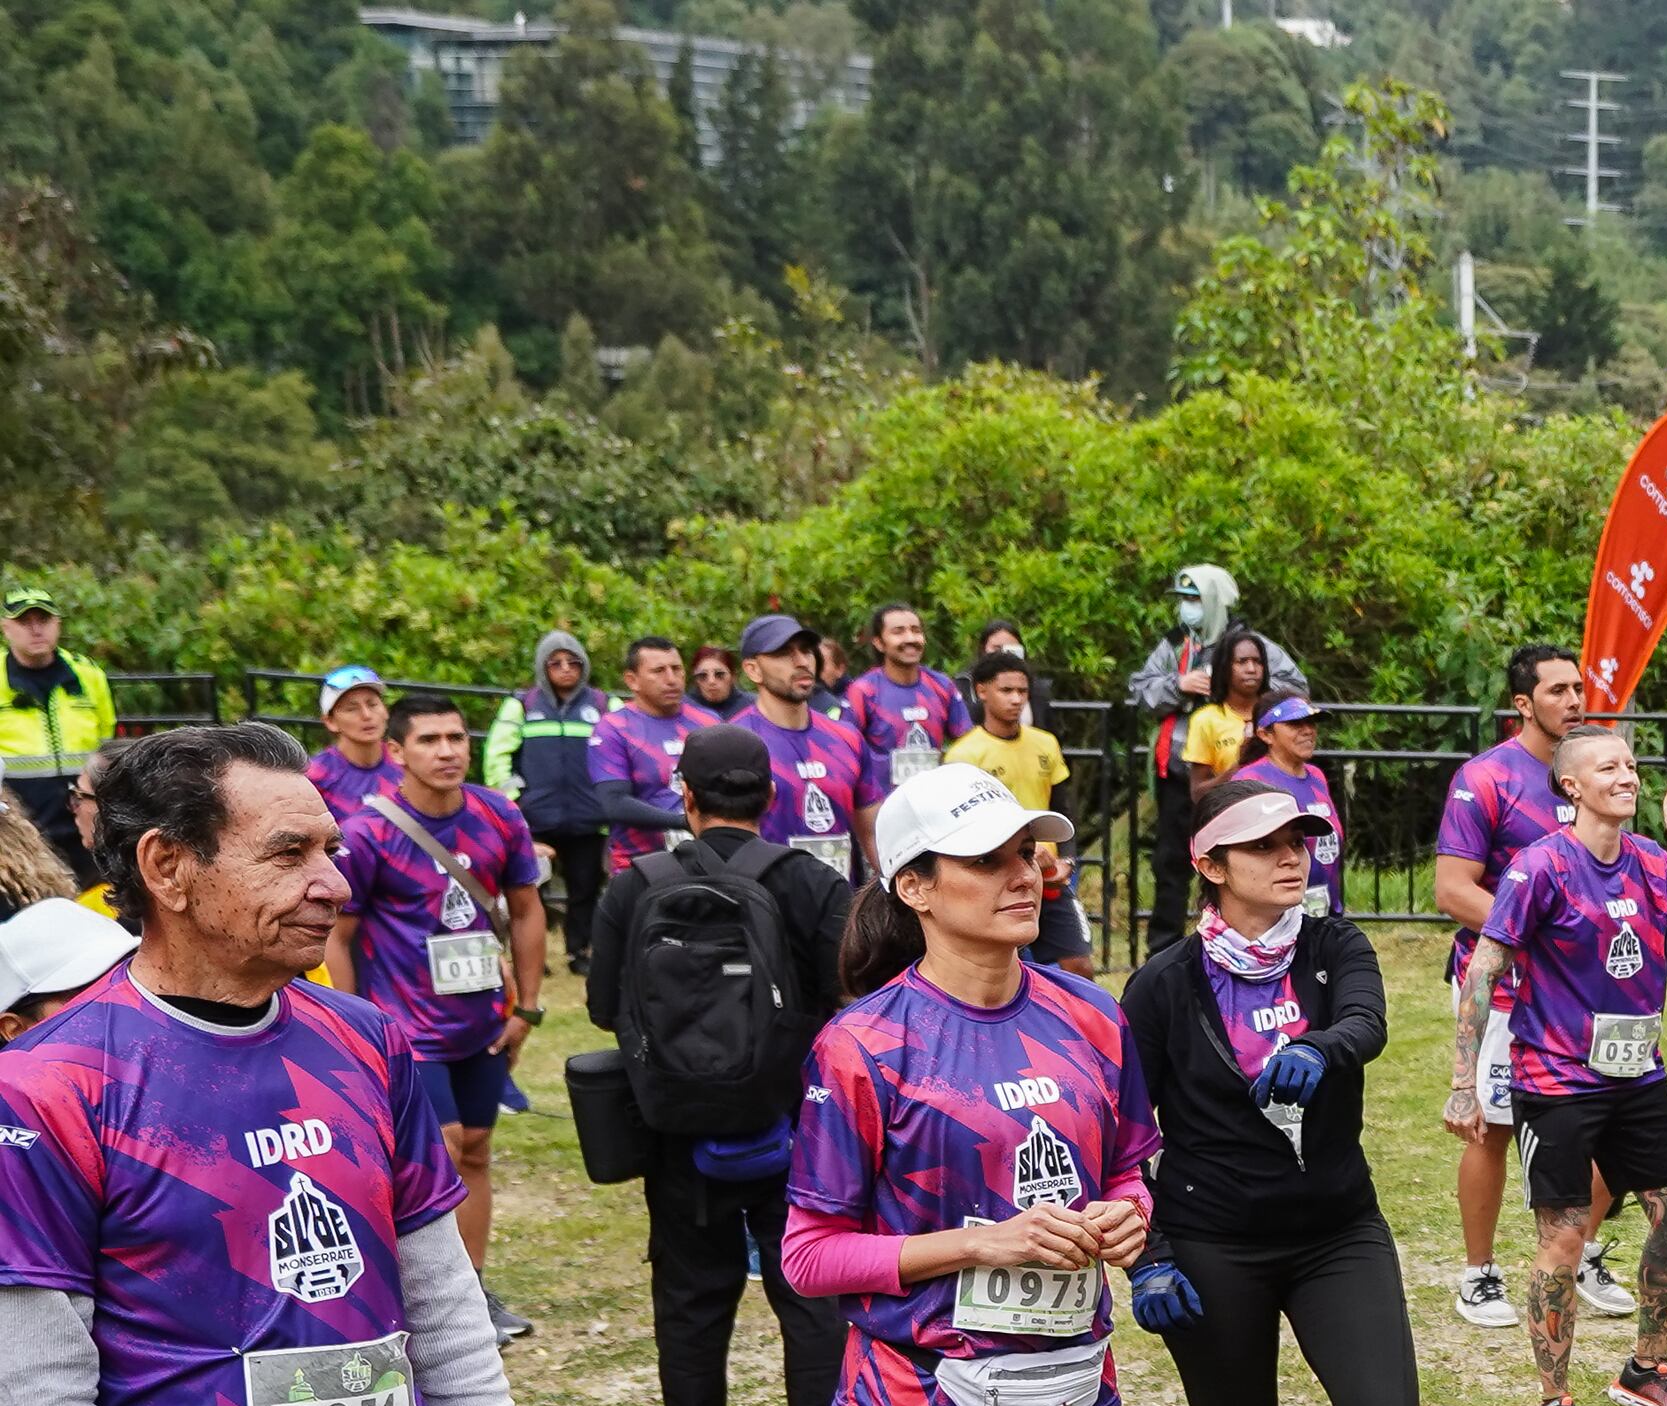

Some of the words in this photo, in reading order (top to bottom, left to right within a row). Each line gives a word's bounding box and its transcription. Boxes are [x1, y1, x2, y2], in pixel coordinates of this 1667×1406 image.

[1253, 1000, 1300, 1032] IDRD
[994, 1077, 1060, 1111] IDRD
[0, 1127, 36, 1148] NZ
[244, 1119, 332, 1168] IDRD
[1019, 1132, 1073, 1183] SUBE
[1020, 1177, 1074, 1194] MONSERRATE
[274, 1190, 352, 1260] SUBE
[278, 1248, 354, 1274] MONSERRATE
[987, 1268, 1087, 1308] 0973
